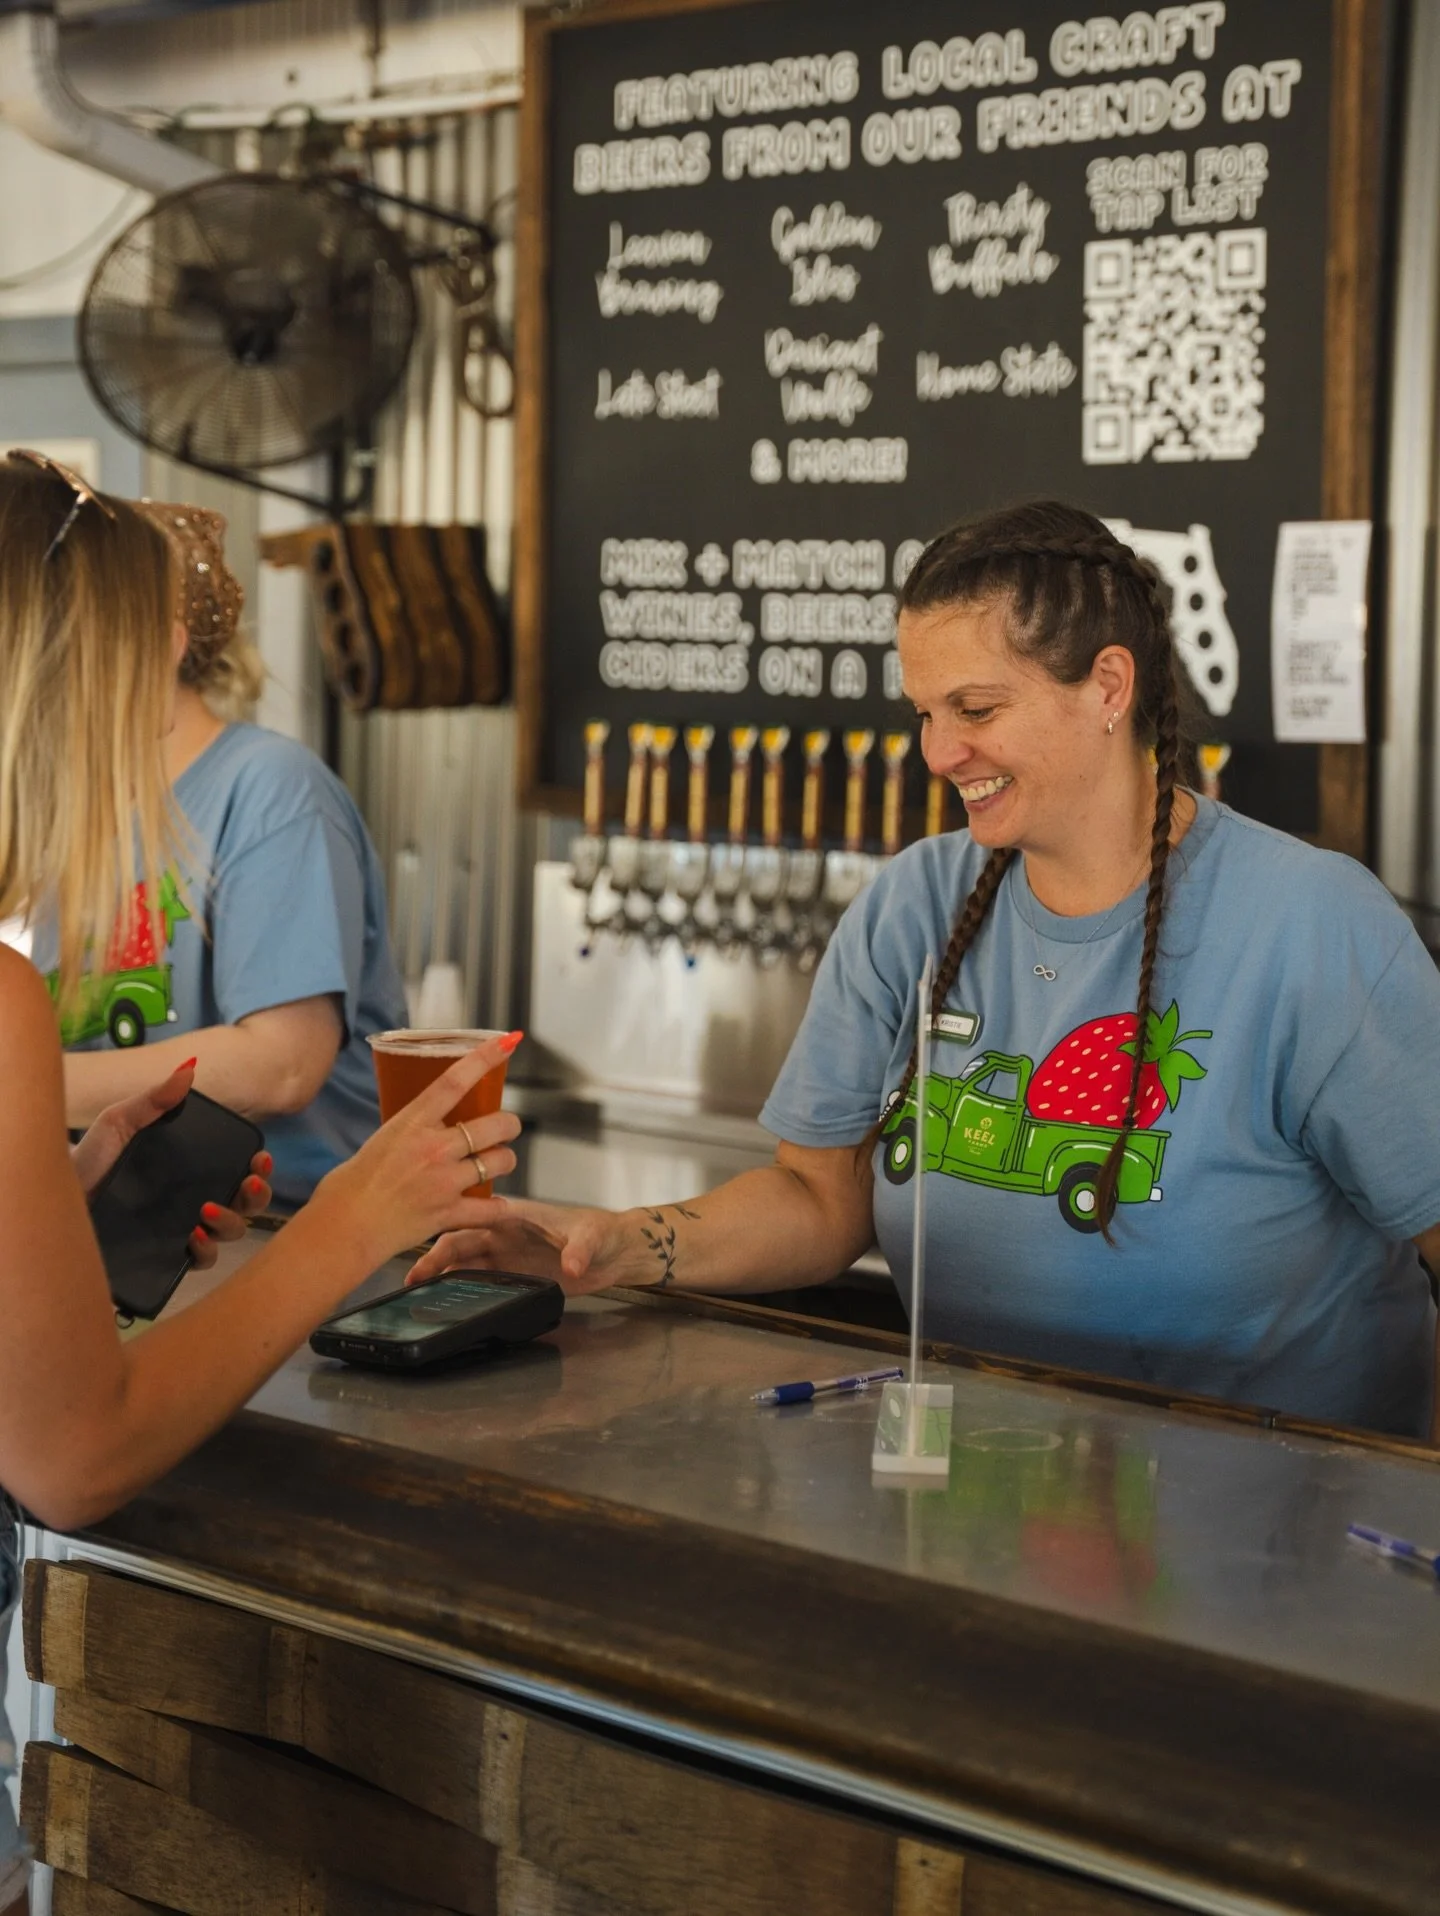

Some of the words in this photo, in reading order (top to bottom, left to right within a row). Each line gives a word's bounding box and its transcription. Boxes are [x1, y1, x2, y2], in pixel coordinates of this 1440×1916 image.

[613, 51, 860, 131] FEATURING
[882, 29, 1038, 99] LOCAL
[1049, 1, 1226, 77] CRAFT
[573, 131, 711, 194] BEERS
[722, 116, 851, 181] FROM
[861, 105, 962, 166] OUR
[977, 70, 1206, 153] FRIENDS
[1222, 58, 1302, 123] AT
[1086, 150, 1187, 194] SCAN
[1194, 142, 1269, 186] FOR
[1089, 188, 1165, 234] TAP
[1170, 180, 1264, 226] LIST
[751, 438, 782, 484] &
[787, 437, 909, 484] MORE!
[600, 538, 689, 588] MIX
[694, 542, 729, 587] +
[731, 538, 886, 590] MATCH
[599, 589, 755, 648] WINES,
[599, 640, 749, 693] CIDERS
[758, 646, 823, 697] ON
[830, 649, 868, 700] A
[963, 1127, 995, 1146] KEEL
